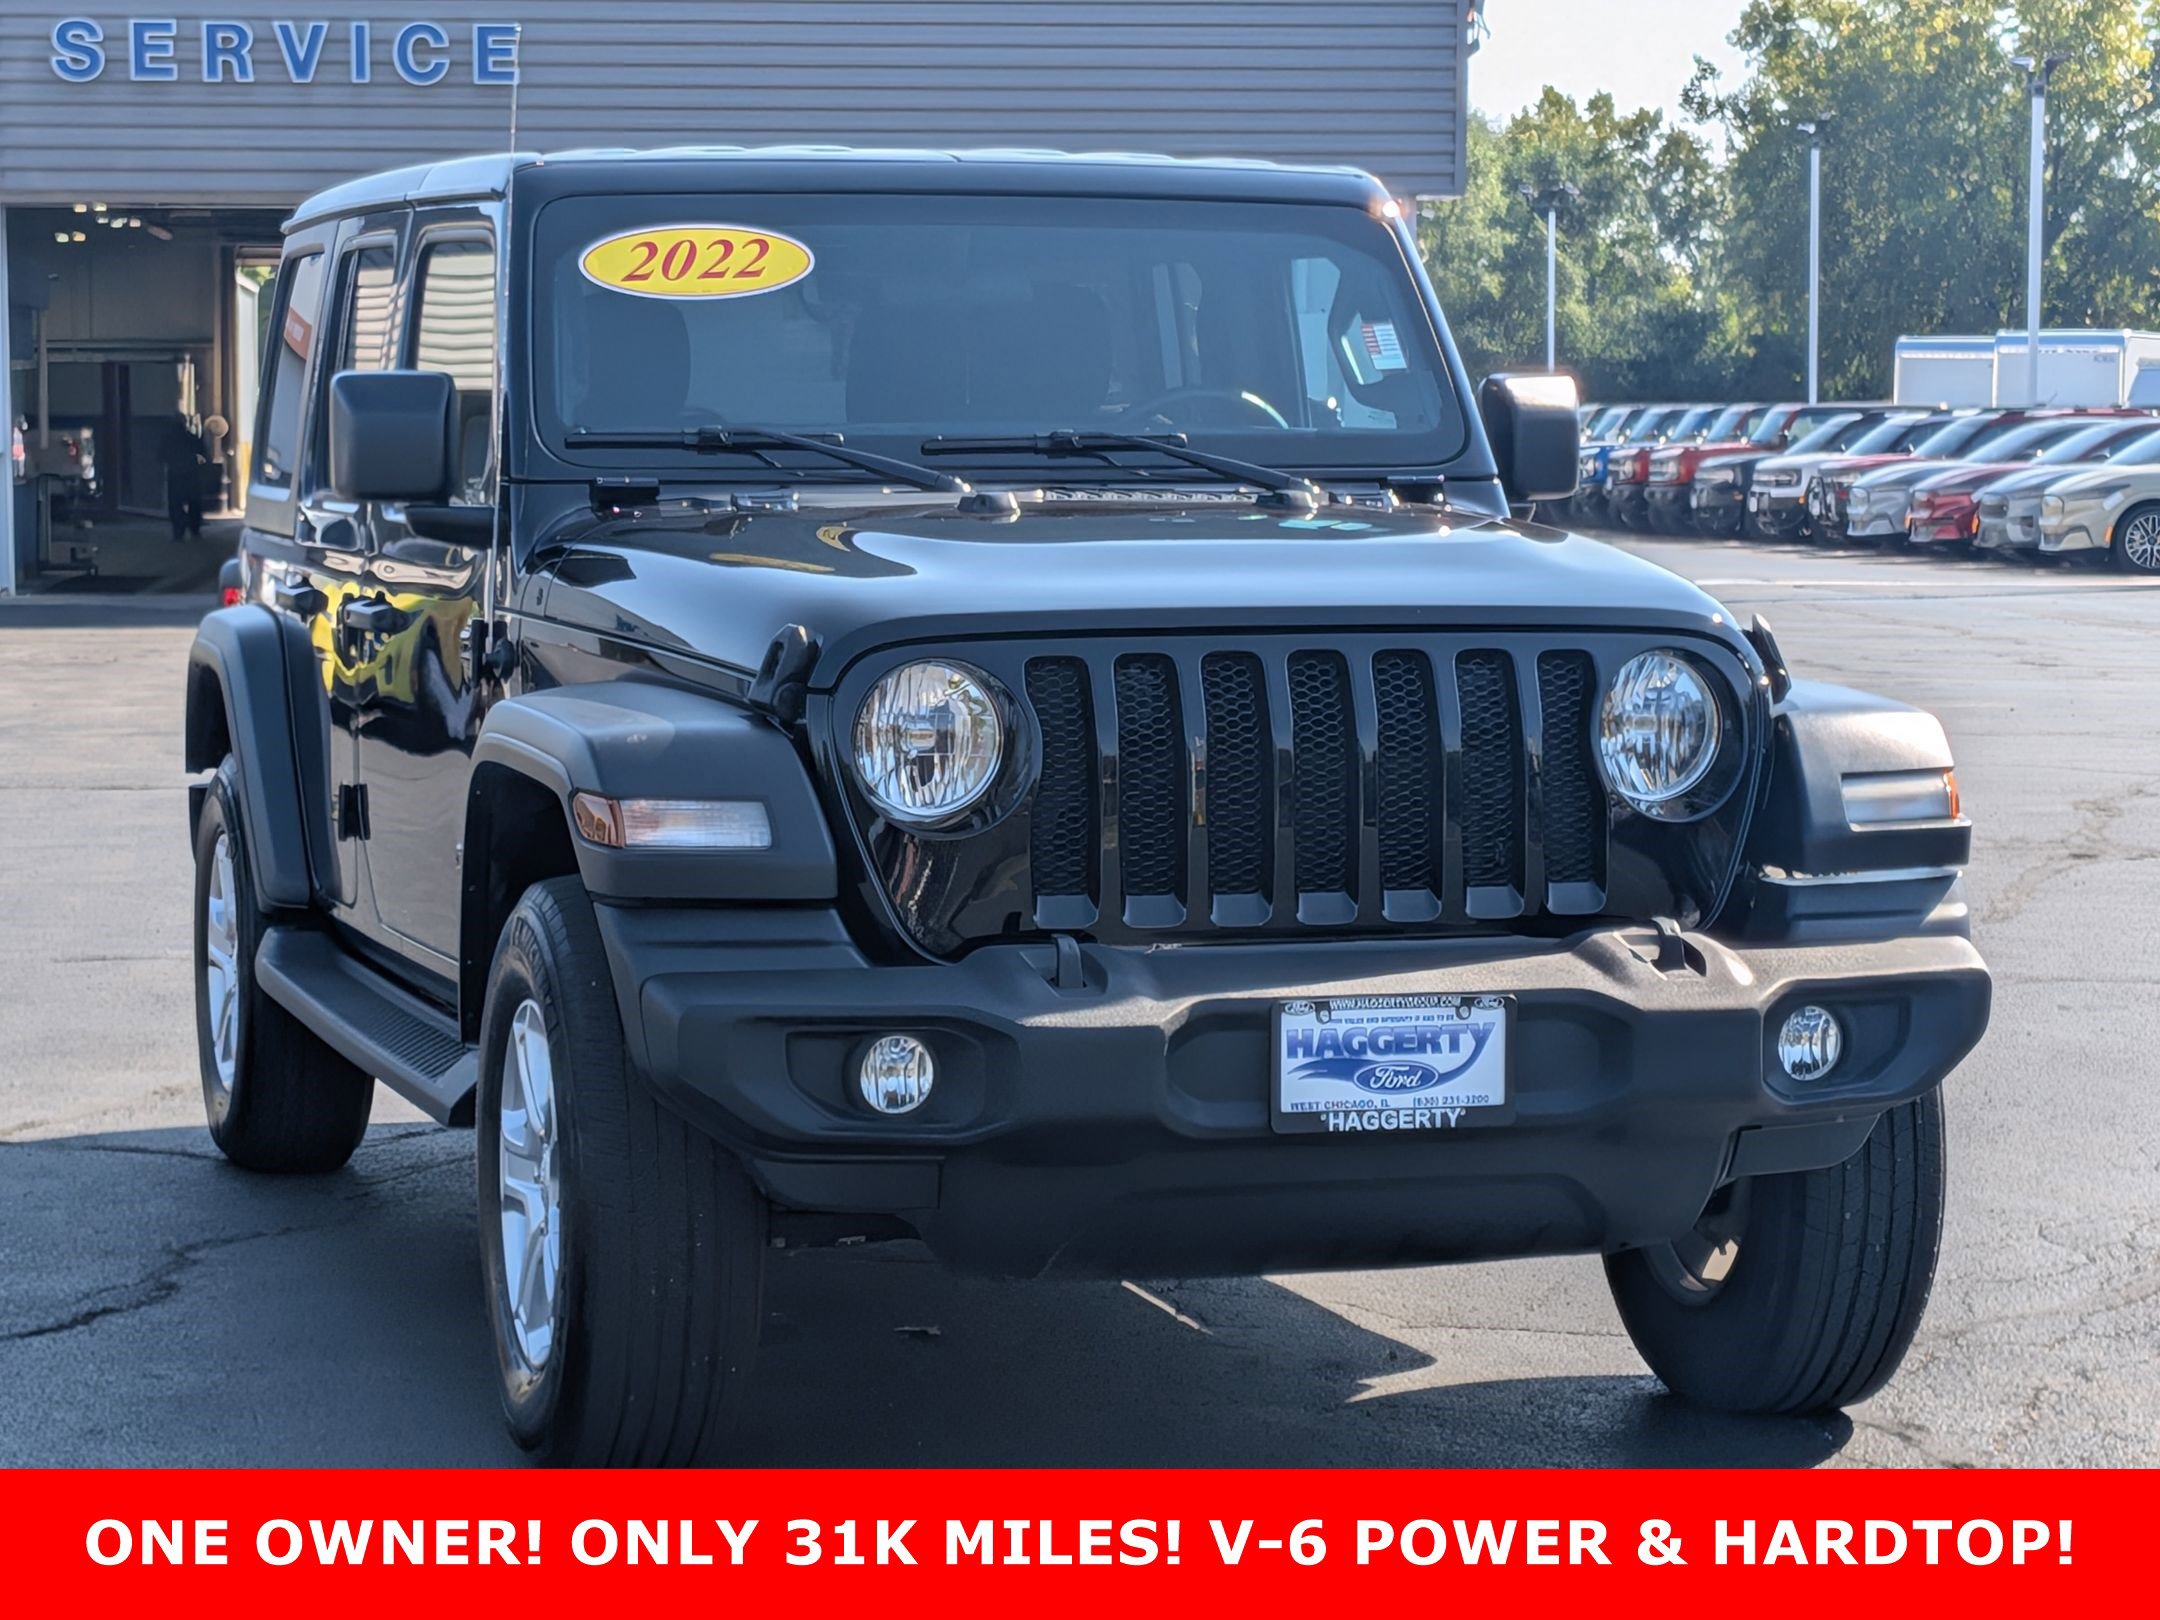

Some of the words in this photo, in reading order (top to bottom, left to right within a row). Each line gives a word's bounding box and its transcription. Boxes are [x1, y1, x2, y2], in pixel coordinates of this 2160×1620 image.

[51, 17, 521, 85] SERVICE
[621, 238, 770, 282] 2022
[1286, 1022, 1496, 1059] HAGGERTY
[1369, 1064, 1422, 1089] Ford
[1328, 1108, 1461, 1132] HAGGERTY
